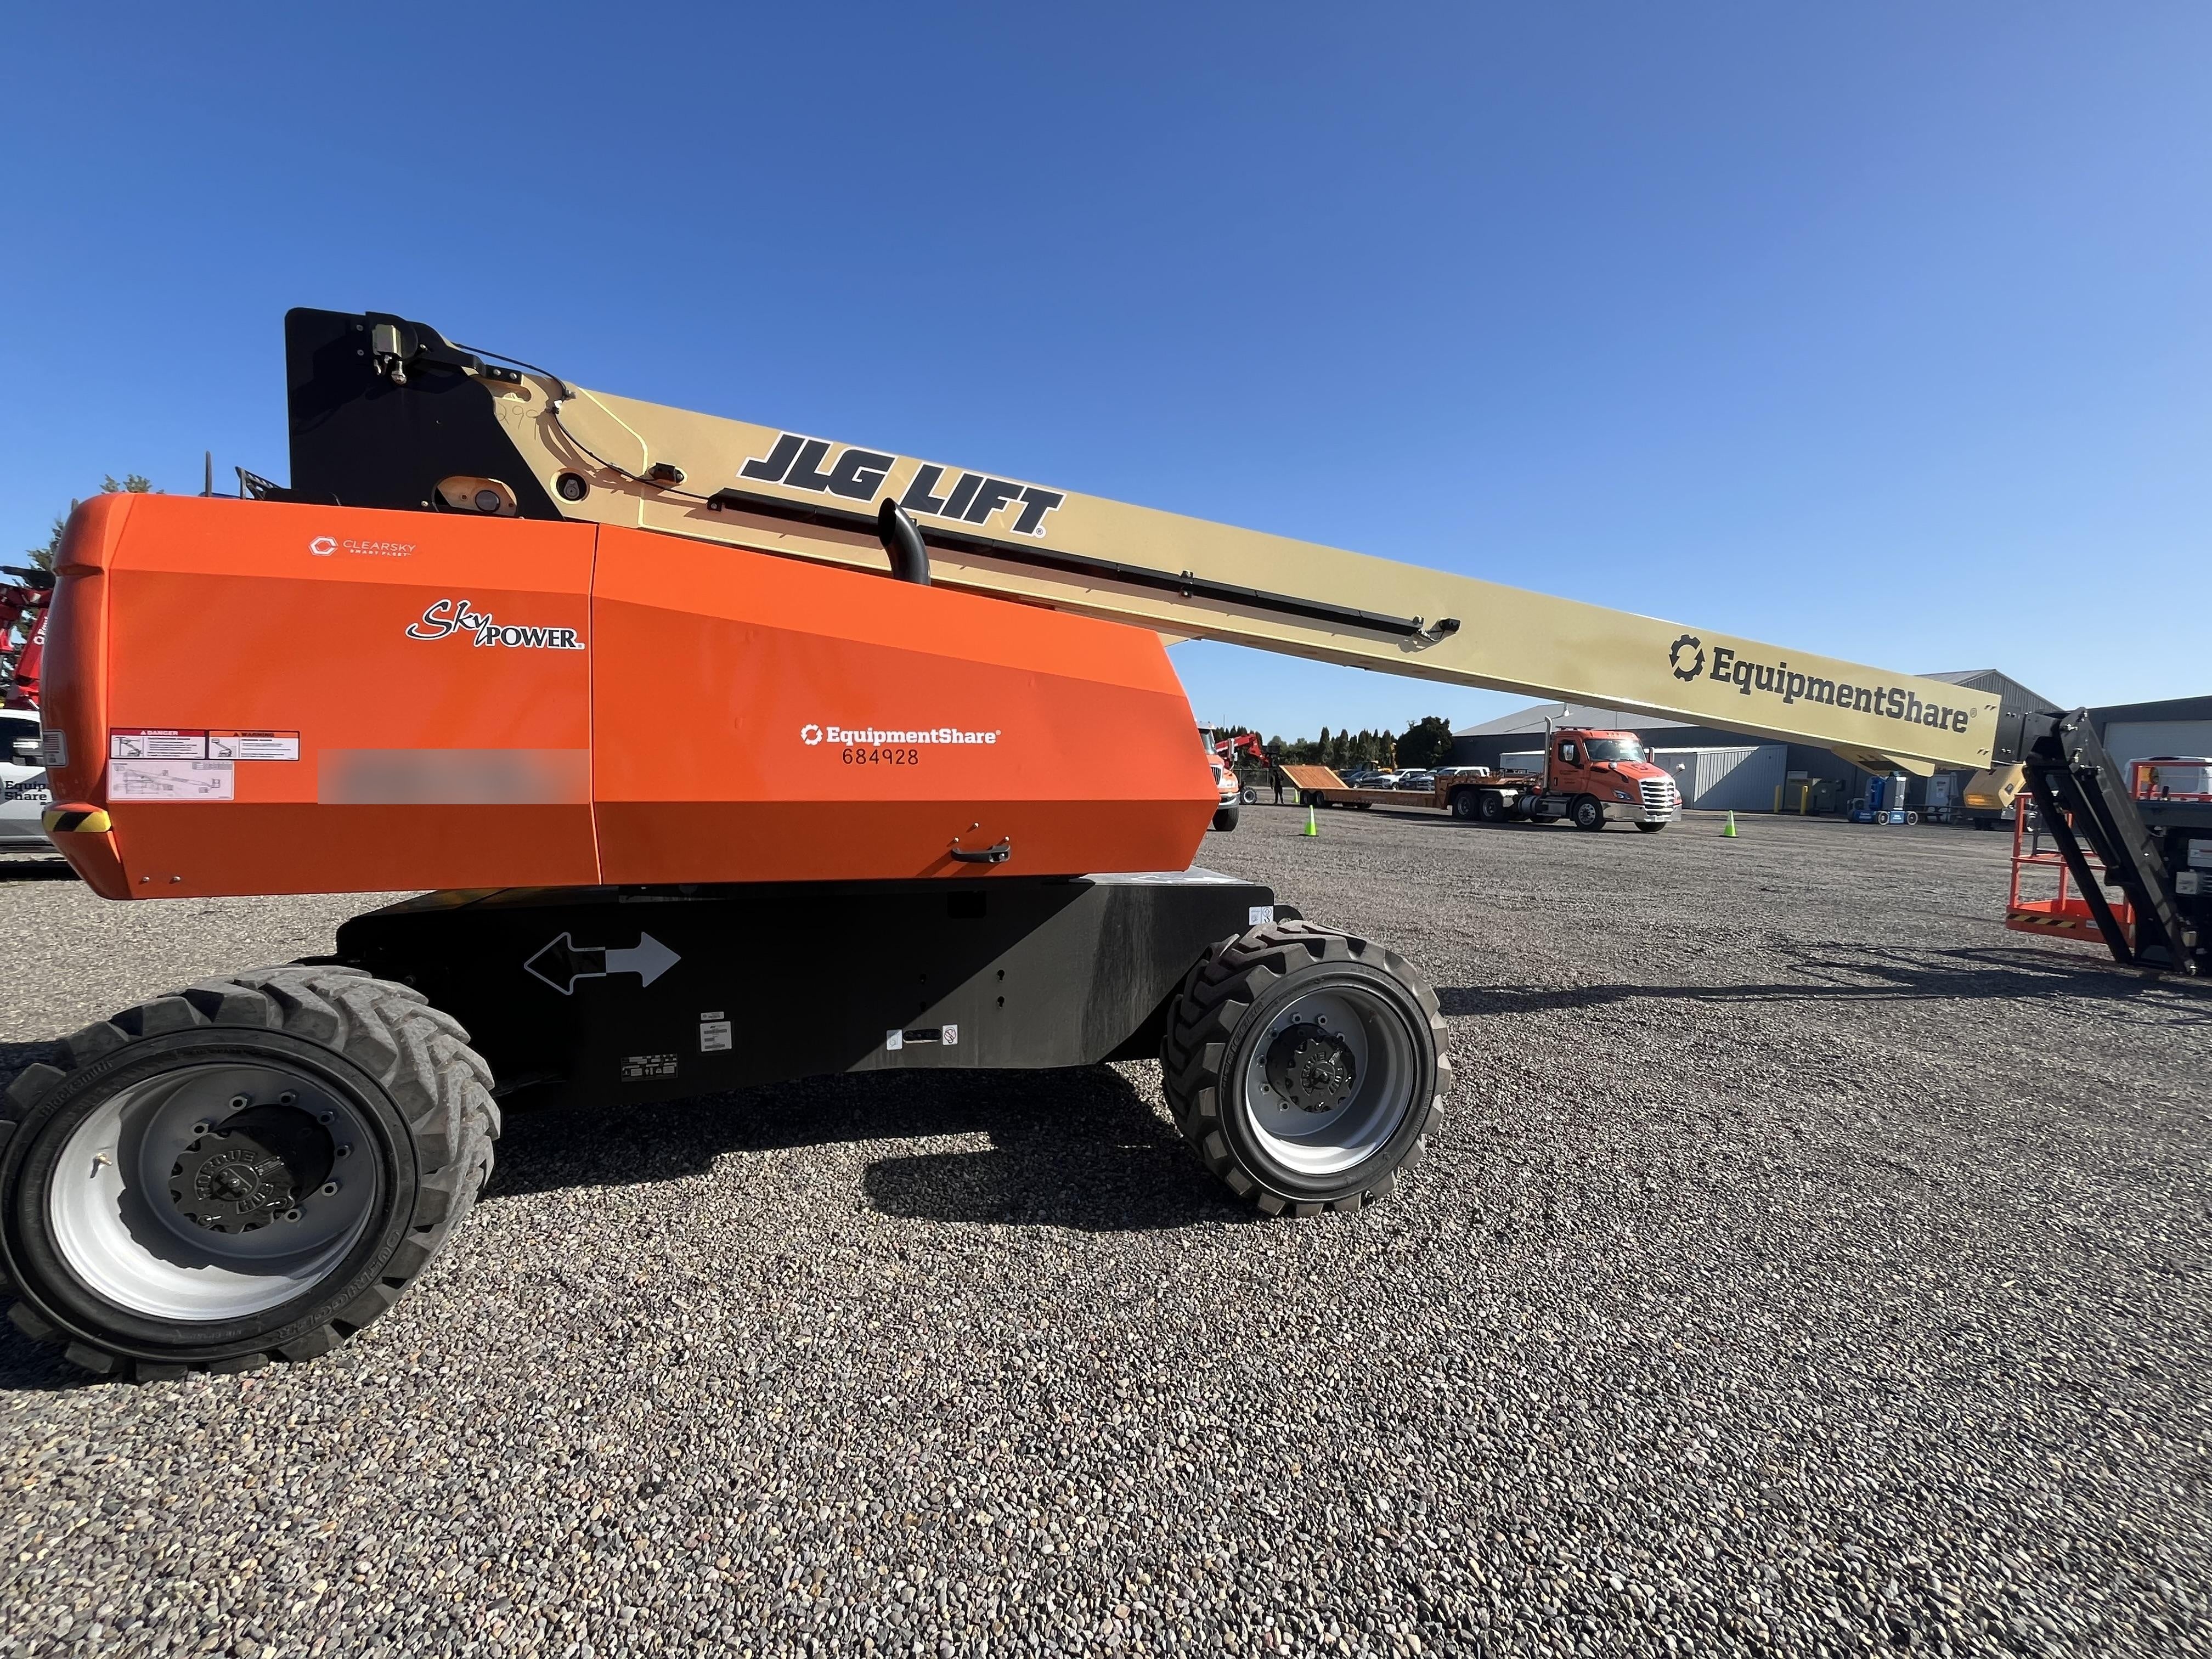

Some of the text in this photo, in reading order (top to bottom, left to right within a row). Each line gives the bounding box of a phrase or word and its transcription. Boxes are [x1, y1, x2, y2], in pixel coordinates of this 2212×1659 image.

[738, 432, 1065, 534] JLG LIFT
[343, 540, 416, 552] CLEARSKY
[842, 748, 919, 765] 684928
[5, 781, 48, 792] Equip
[4, 791, 47, 800] Share
